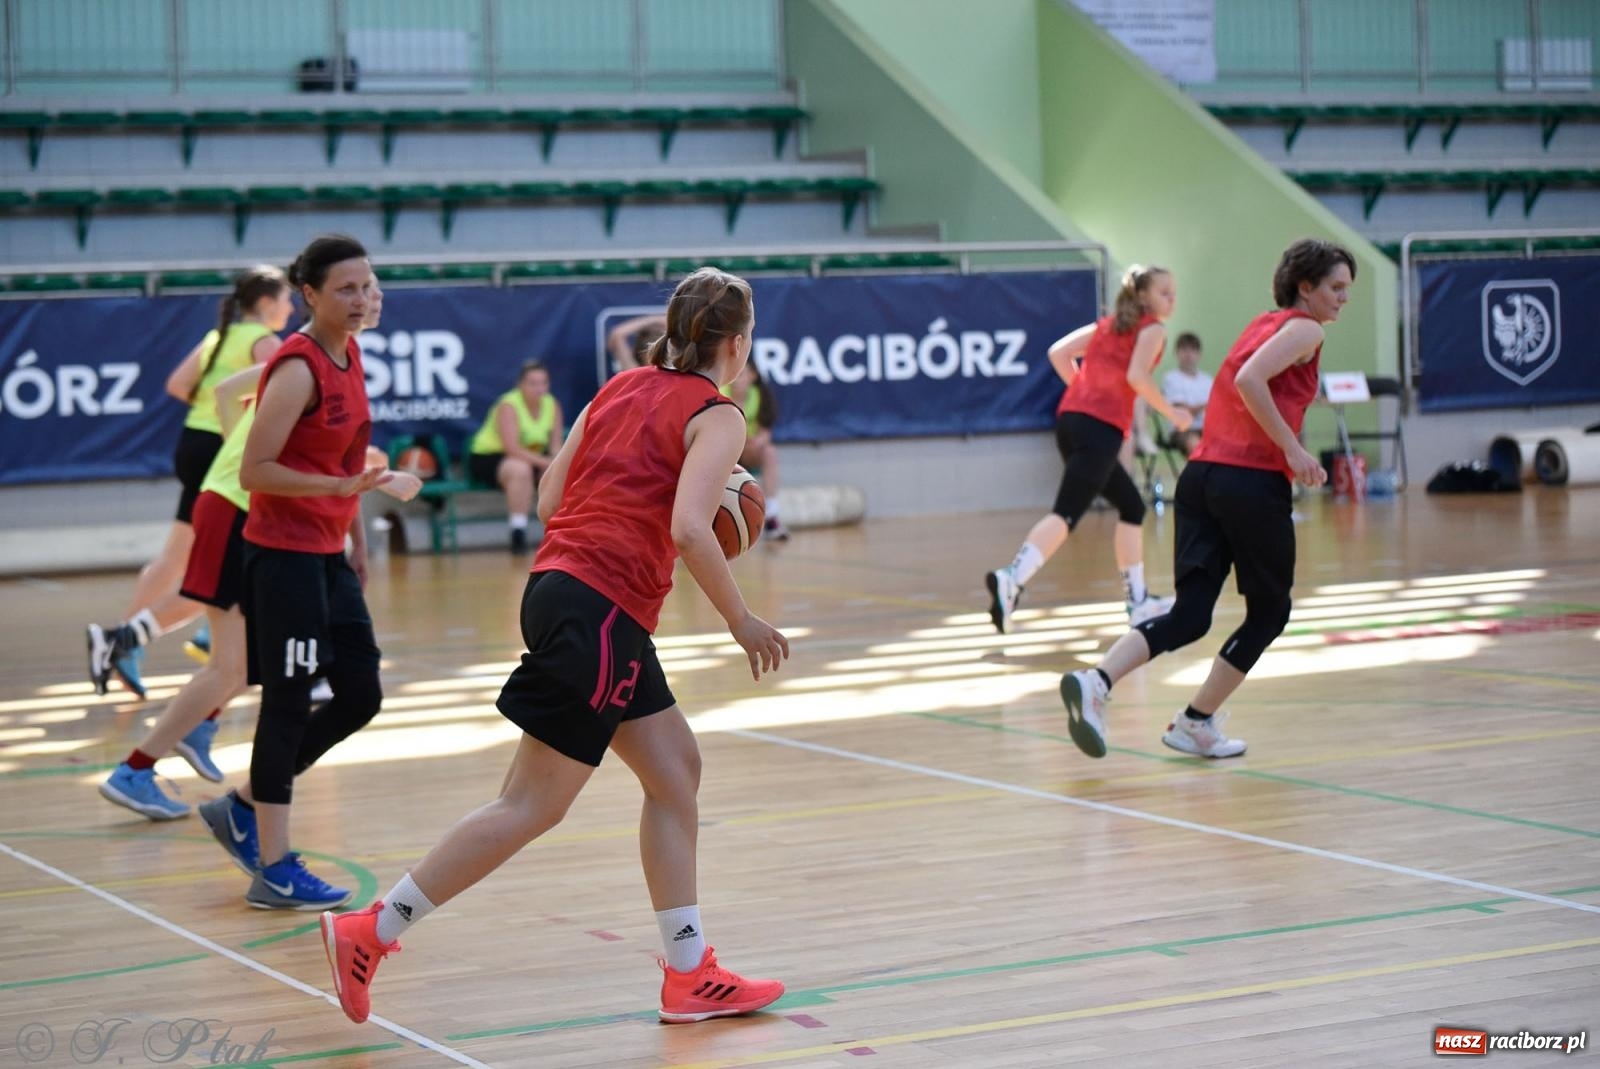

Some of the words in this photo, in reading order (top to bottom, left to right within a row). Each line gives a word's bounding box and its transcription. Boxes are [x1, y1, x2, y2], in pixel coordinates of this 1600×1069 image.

[752, 316, 1028, 385] RACIBÓRZ
[0, 348, 144, 419] ÓRZ
[285, 637, 319, 677] 14
[673, 931, 698, 942] adidas
